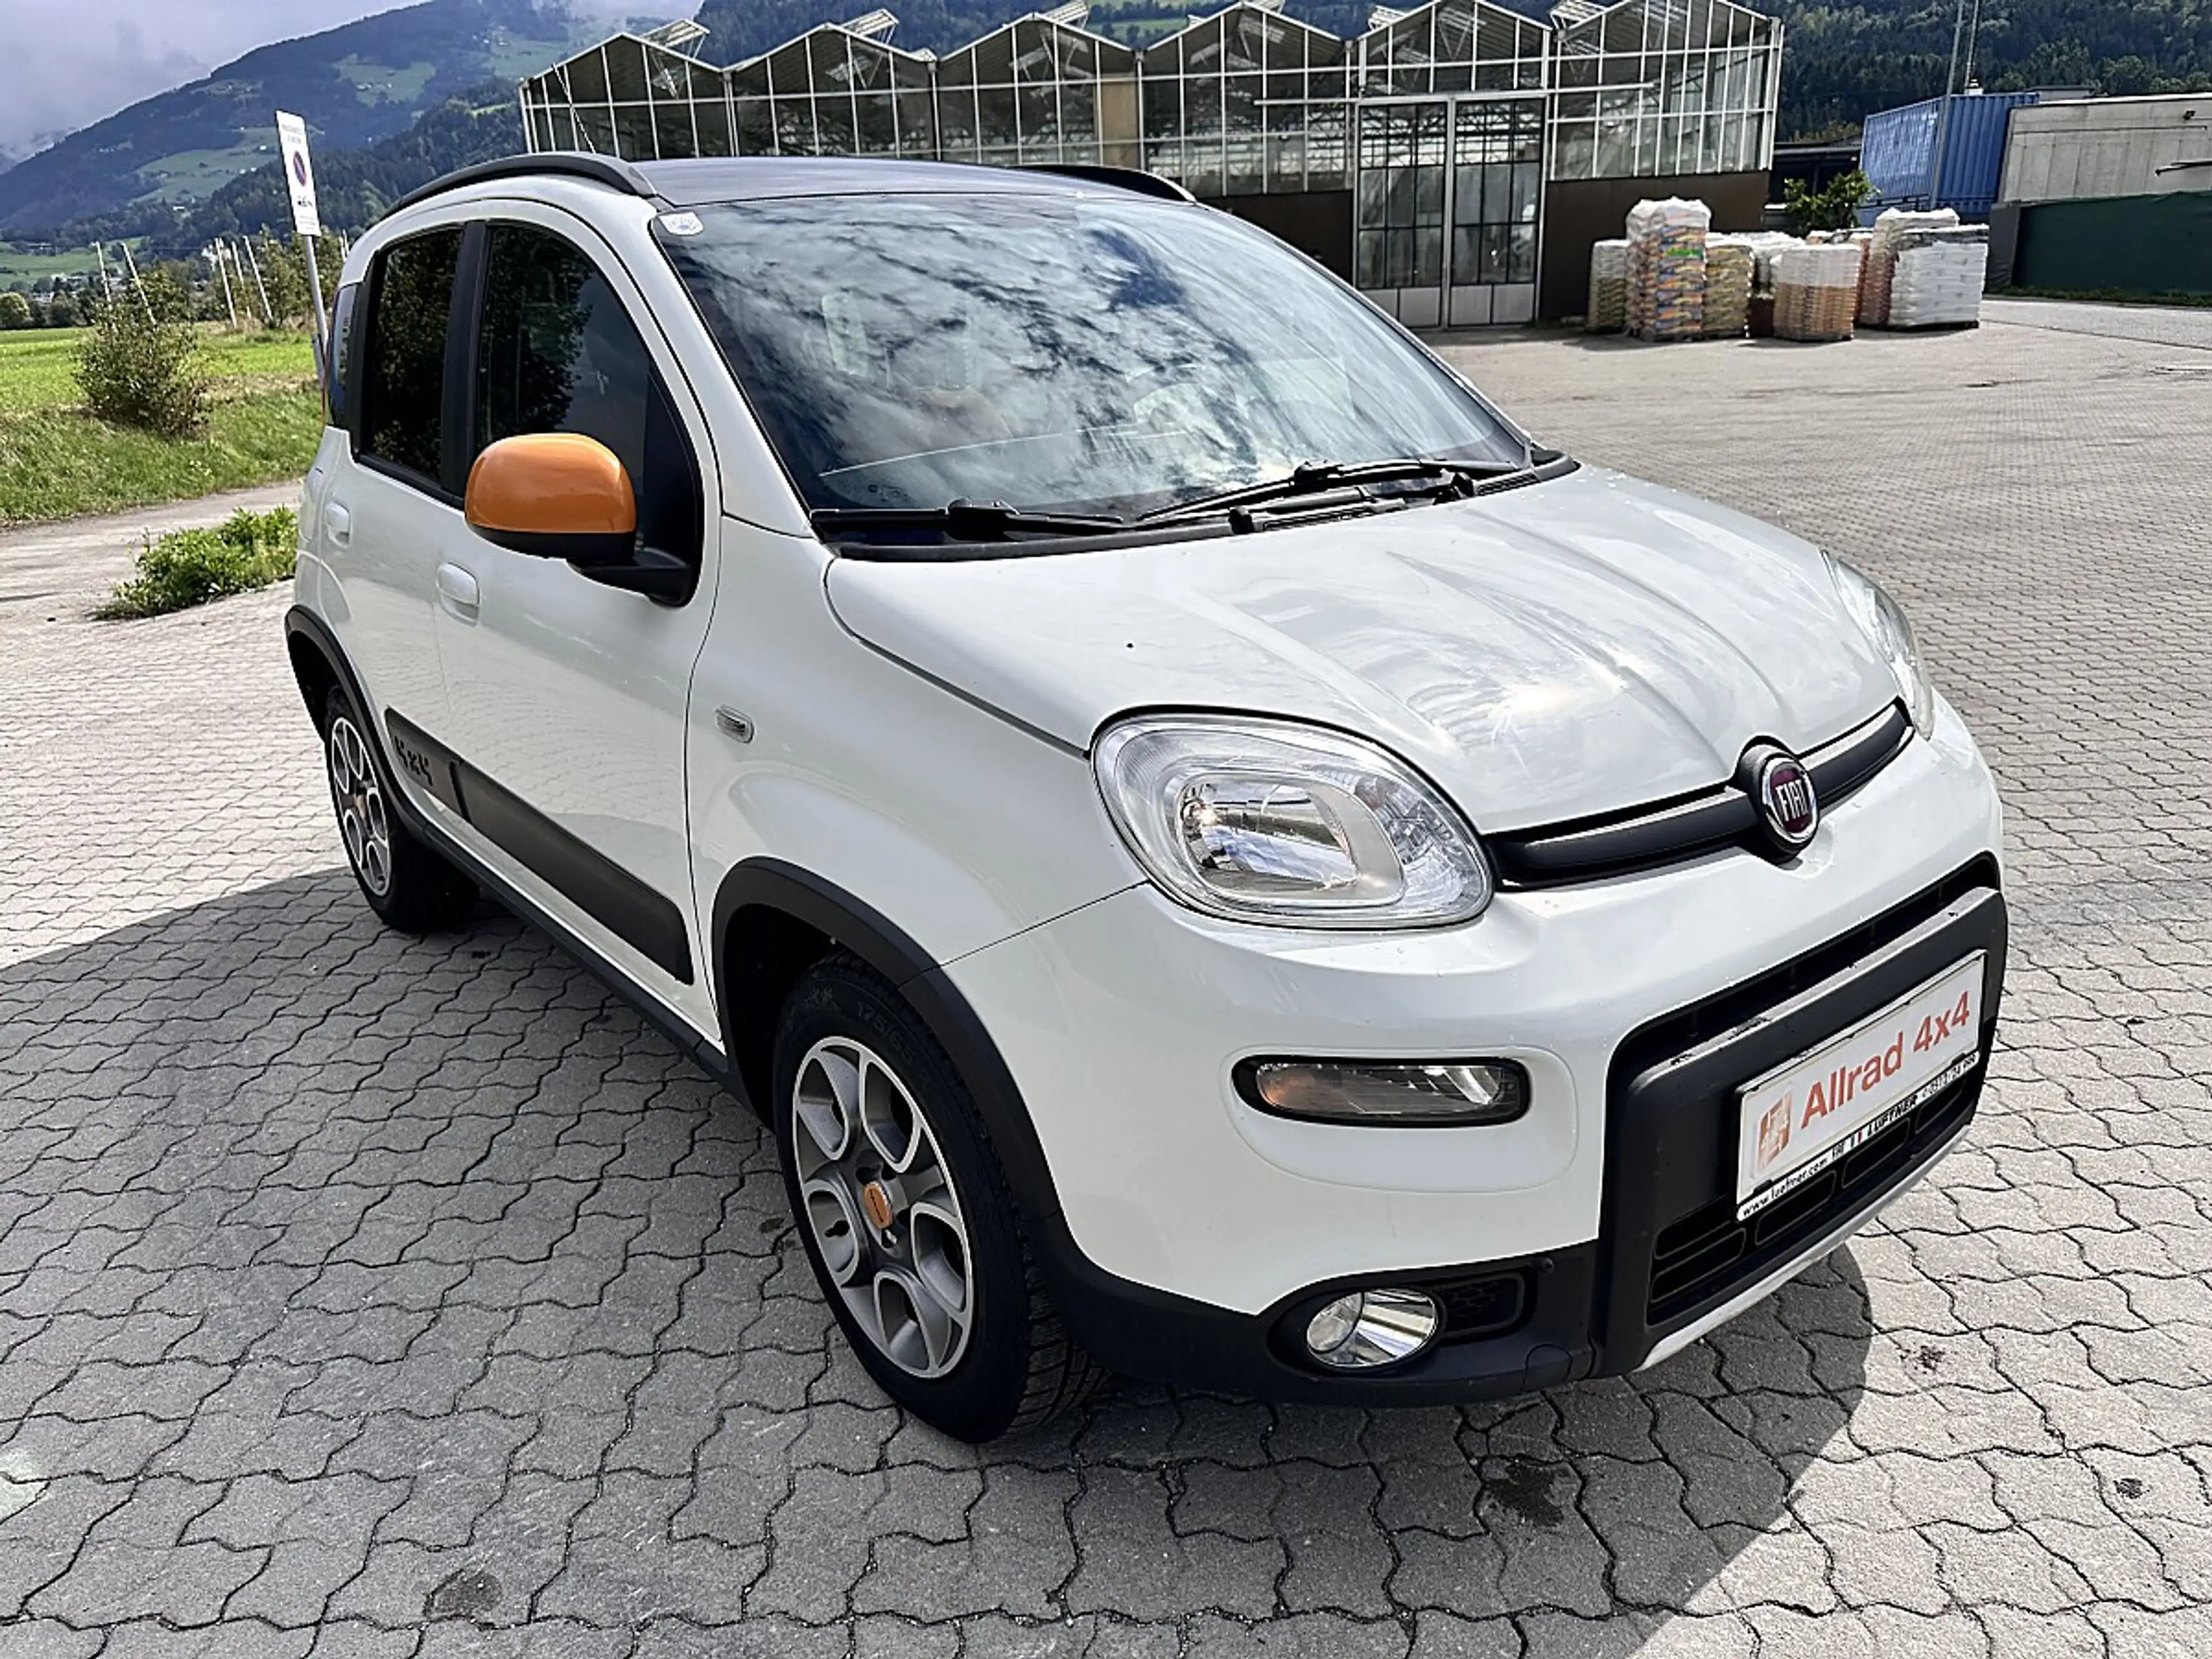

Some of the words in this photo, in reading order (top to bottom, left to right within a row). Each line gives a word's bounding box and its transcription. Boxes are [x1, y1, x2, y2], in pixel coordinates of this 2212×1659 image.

[1775, 779, 1809, 822] FIAT
[1800, 1031, 1904, 1130] Allrad
[1913, 991, 1970, 1052] 4x4
